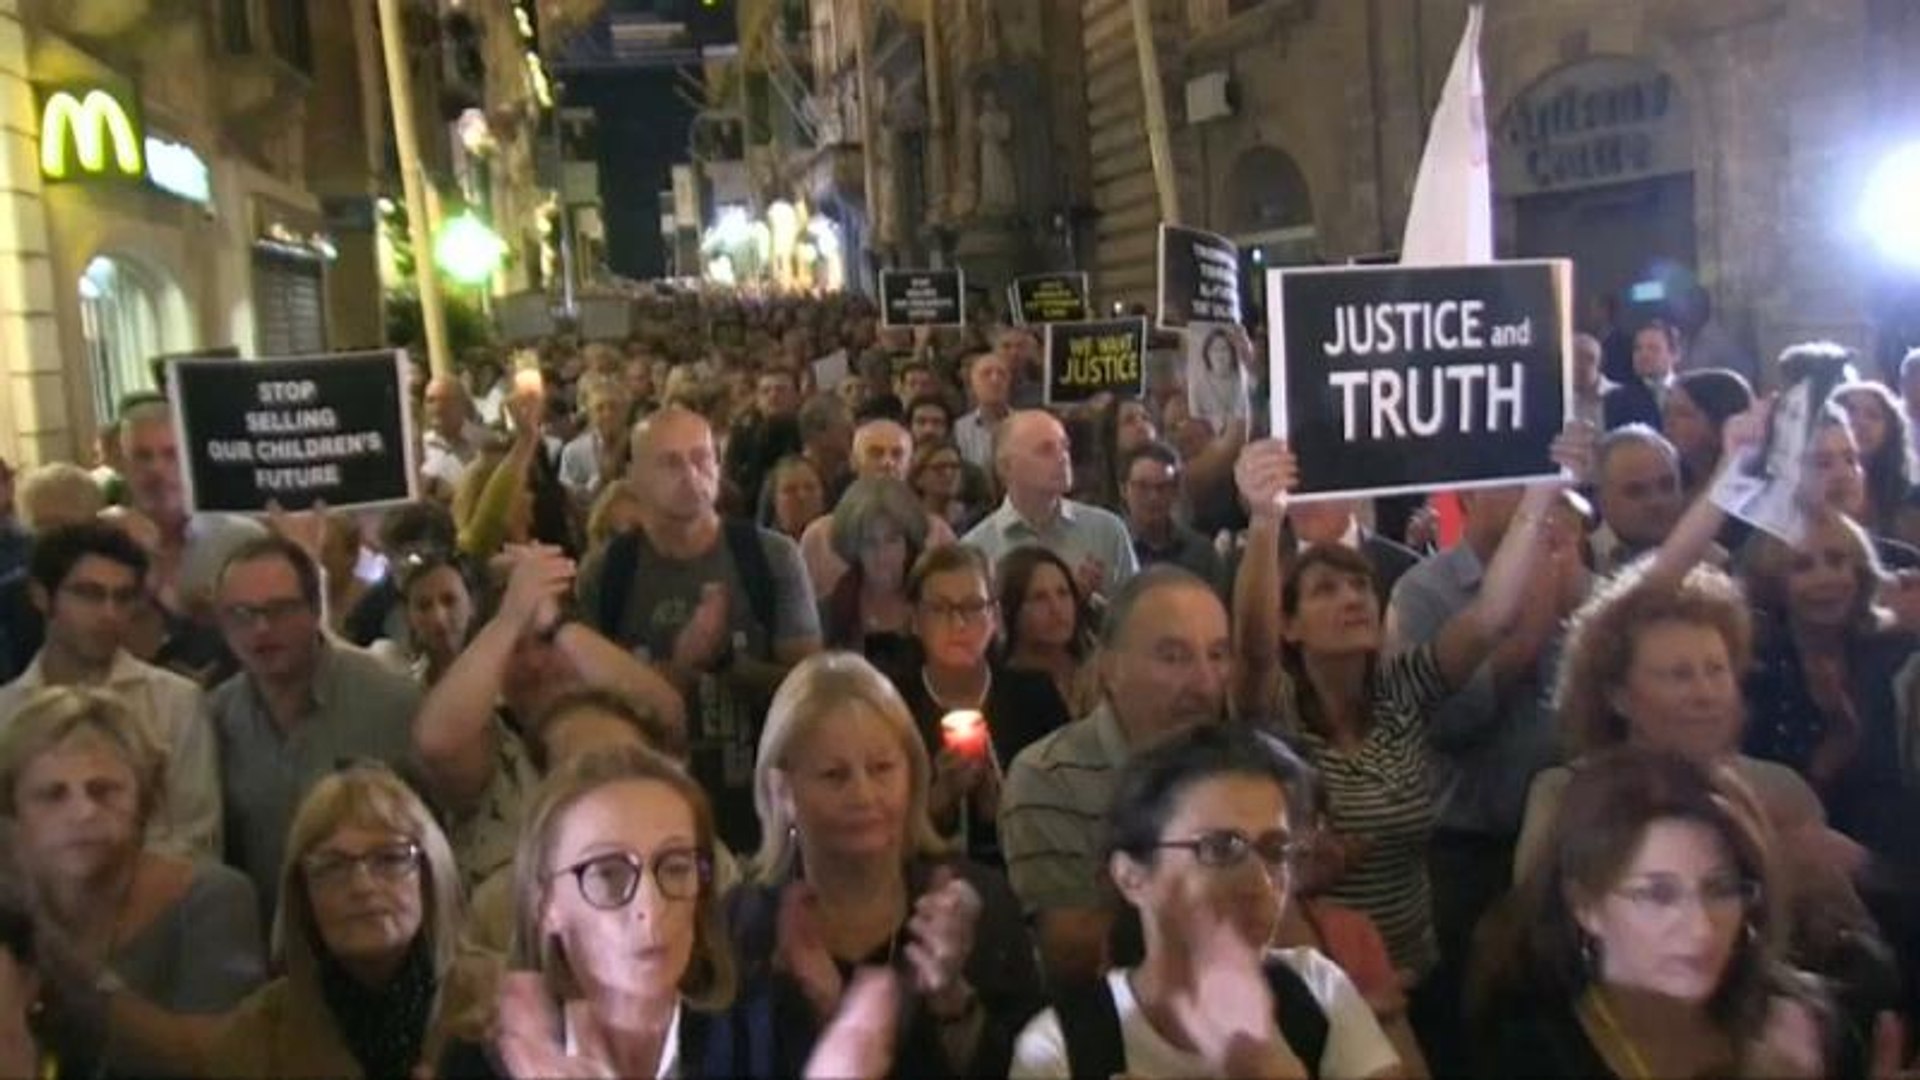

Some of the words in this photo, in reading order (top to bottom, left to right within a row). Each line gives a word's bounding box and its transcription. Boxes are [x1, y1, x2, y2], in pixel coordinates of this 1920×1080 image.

[1322, 300, 1486, 357] JUSTICE
[1490, 317, 1532, 347] and
[1058, 351, 1138, 385] JUSTICE
[257, 379, 317, 403] STOP
[1328, 361, 1525, 441] TRUTH
[245, 407, 337, 433] SELLING
[207, 440, 253, 462] OUR
[256, 432, 383, 462] CHILDREN'S
[255, 464, 340, 489] FUTURE
